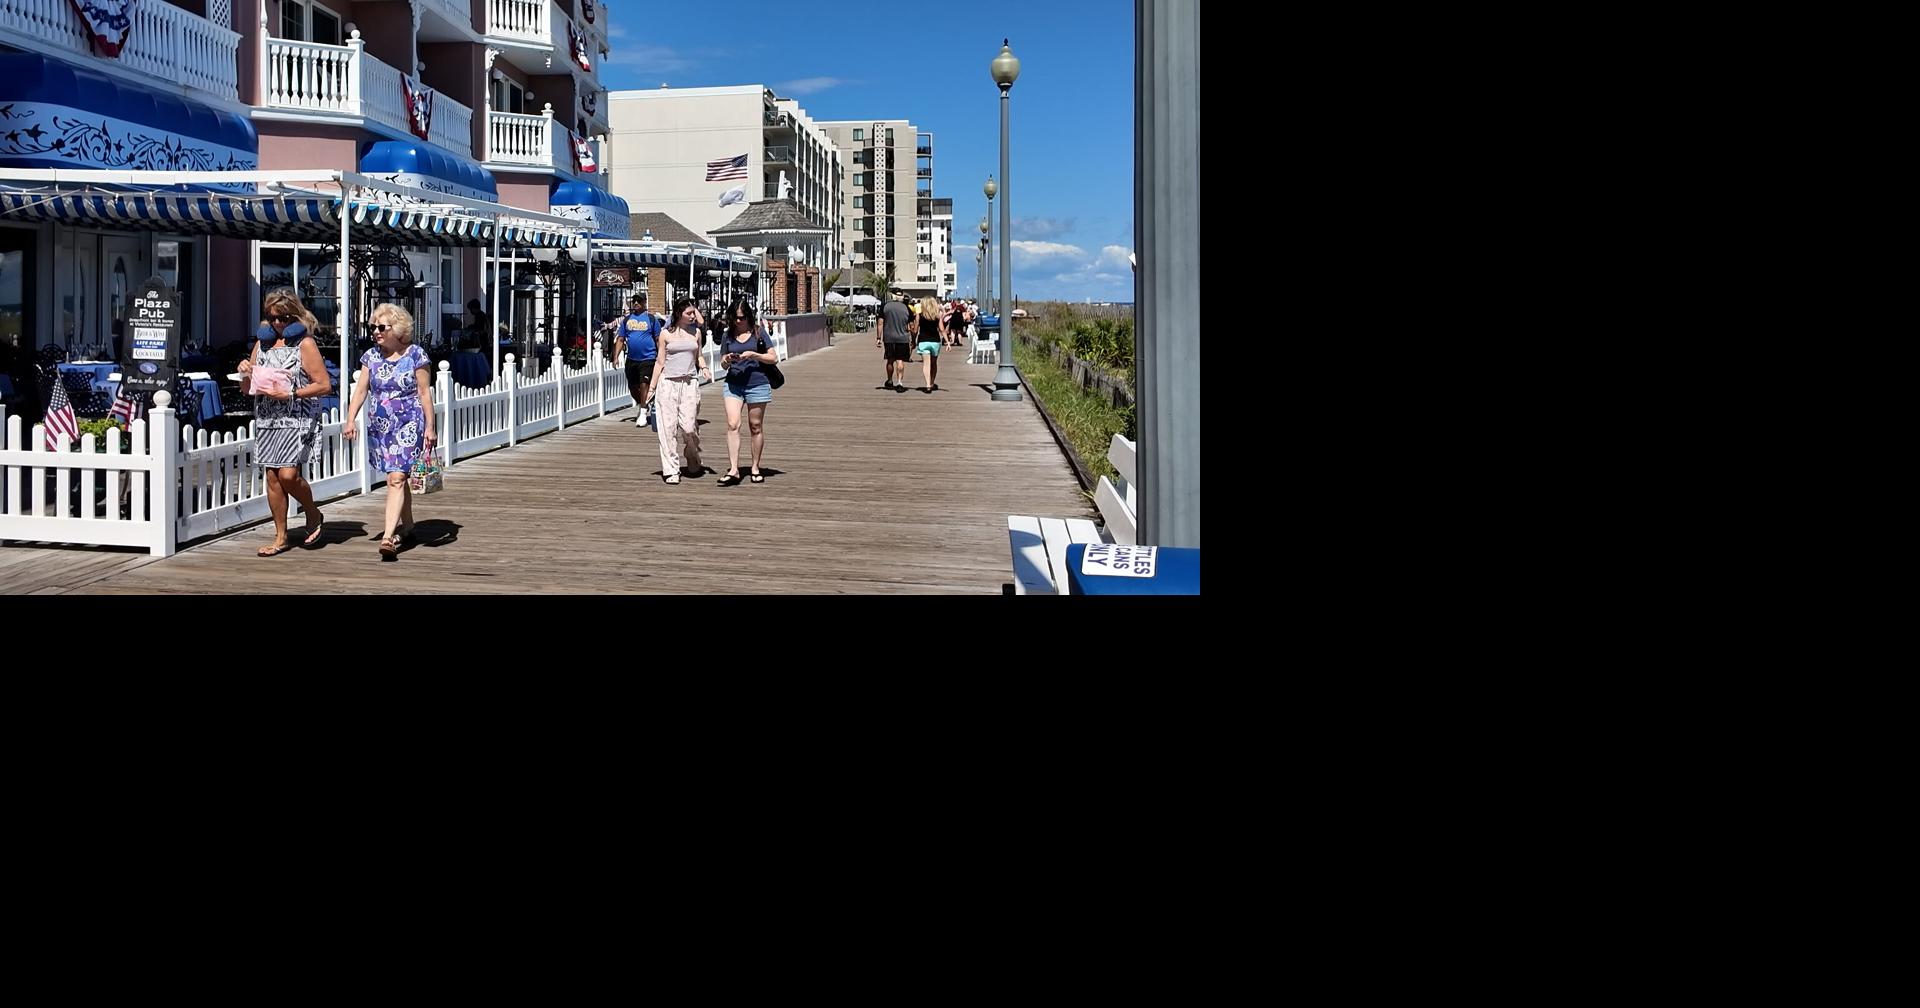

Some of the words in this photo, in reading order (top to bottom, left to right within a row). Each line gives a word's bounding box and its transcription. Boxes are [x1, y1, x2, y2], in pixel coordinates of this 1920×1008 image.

[134, 298, 171, 308] Plaza
[139, 308, 165, 318] Pub
[1113, 547, 1132, 569] CANS
